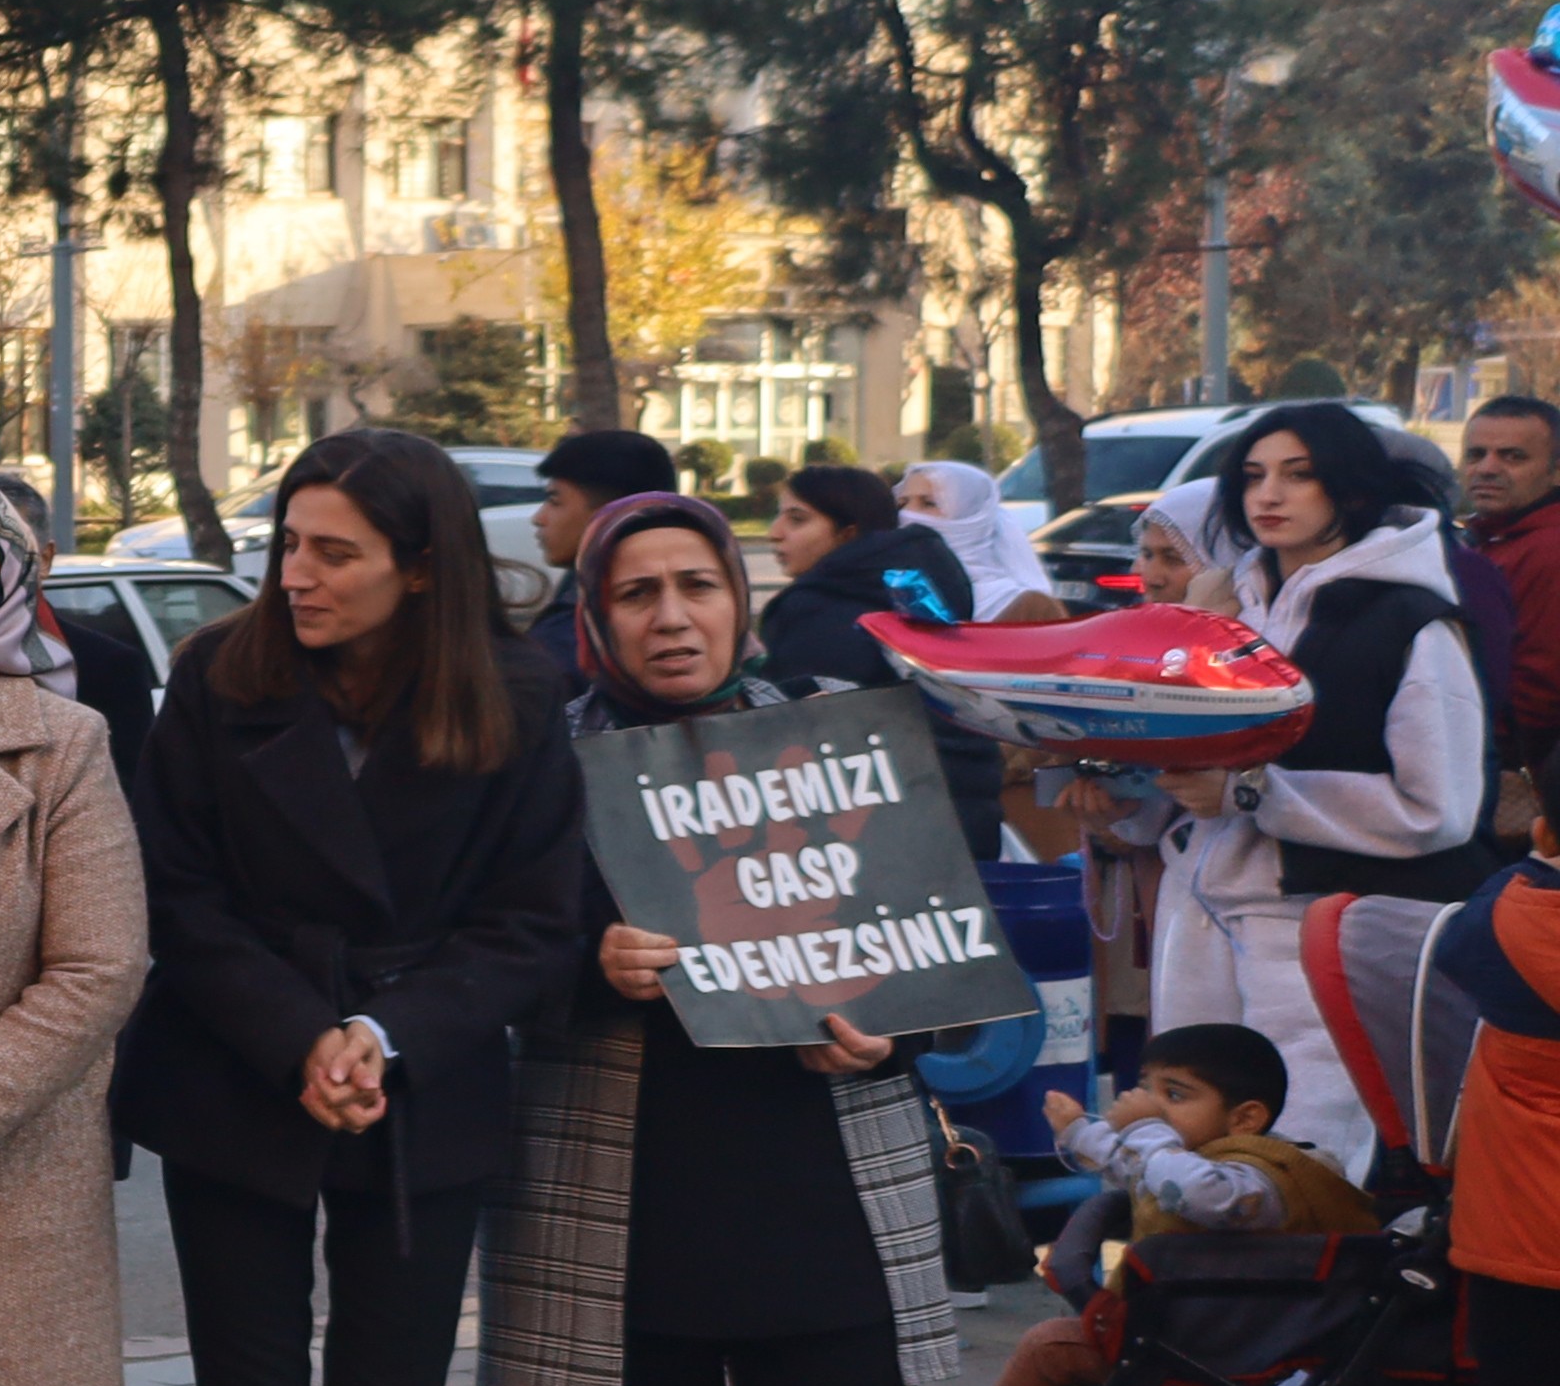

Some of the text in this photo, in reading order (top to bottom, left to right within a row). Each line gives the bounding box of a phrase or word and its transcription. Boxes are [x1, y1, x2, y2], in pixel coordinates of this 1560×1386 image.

[637, 734, 902, 841] İRADEMİZİ
[737, 842, 859, 909] GASP
[677, 895, 998, 995] EDEMEZSİNİZ
